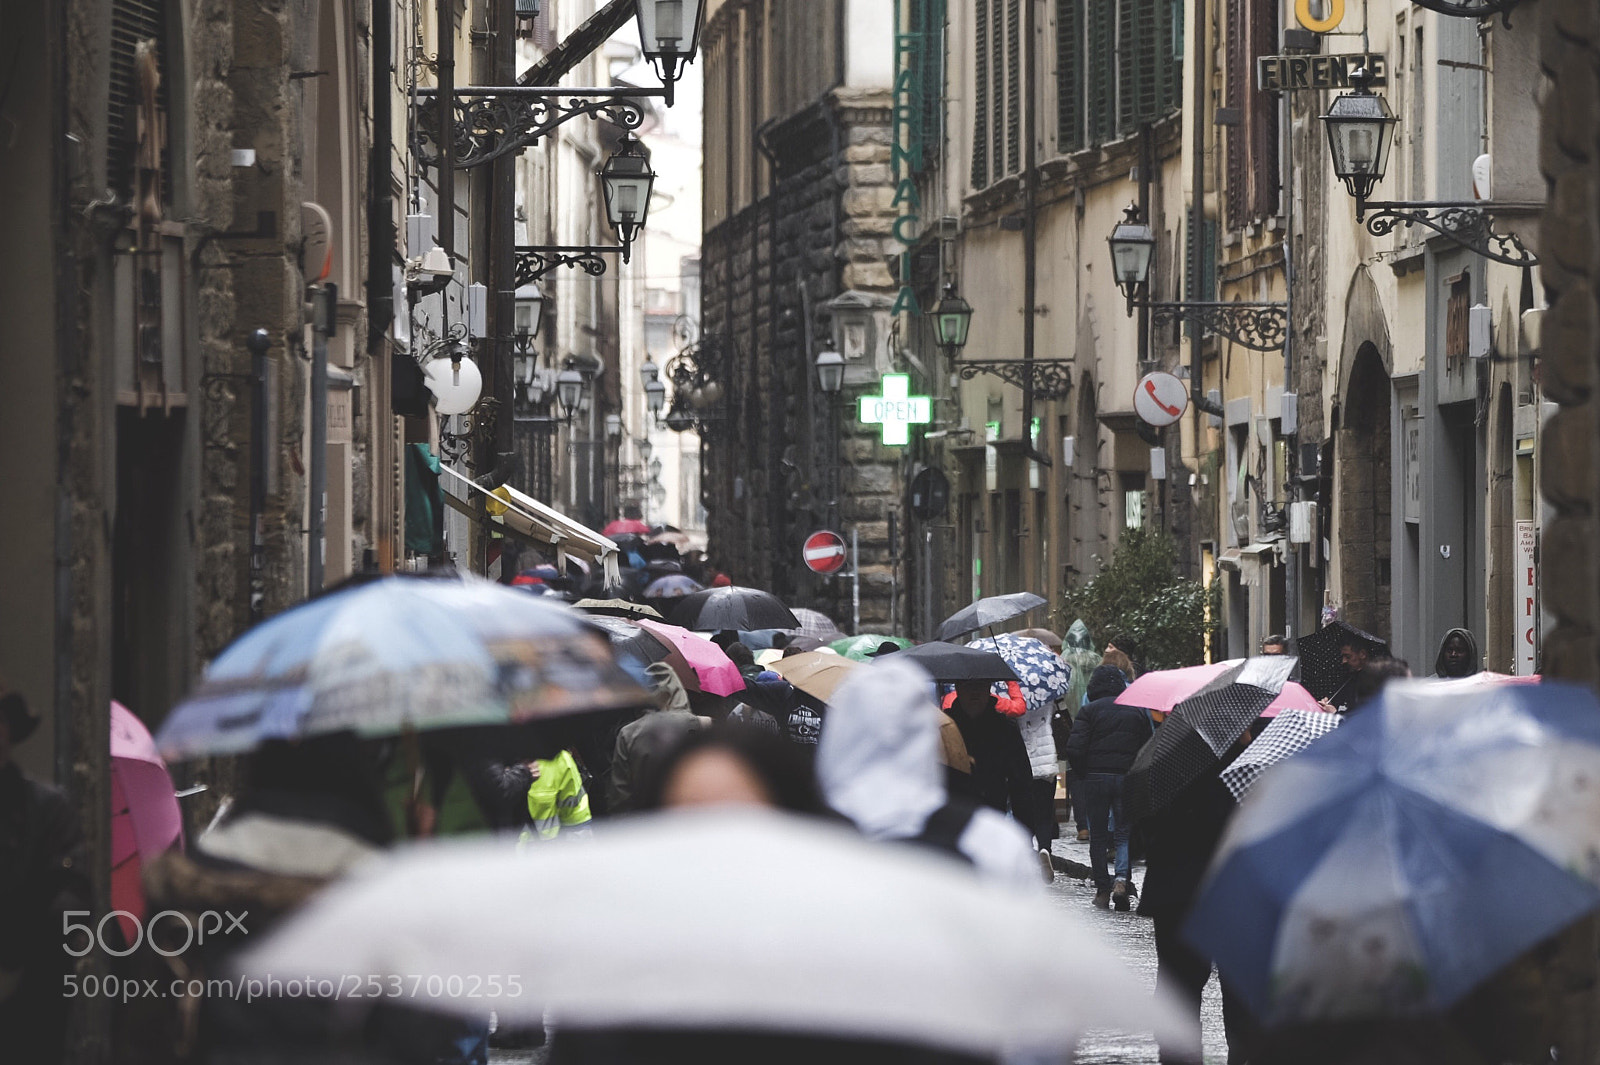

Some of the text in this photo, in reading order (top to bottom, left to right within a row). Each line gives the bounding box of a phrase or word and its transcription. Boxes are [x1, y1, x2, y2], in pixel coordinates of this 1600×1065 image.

[1260, 55, 1386, 88] FIRENZE
[891, 33, 923, 317] FARMACIA
[874, 401, 917, 421] OPEN
